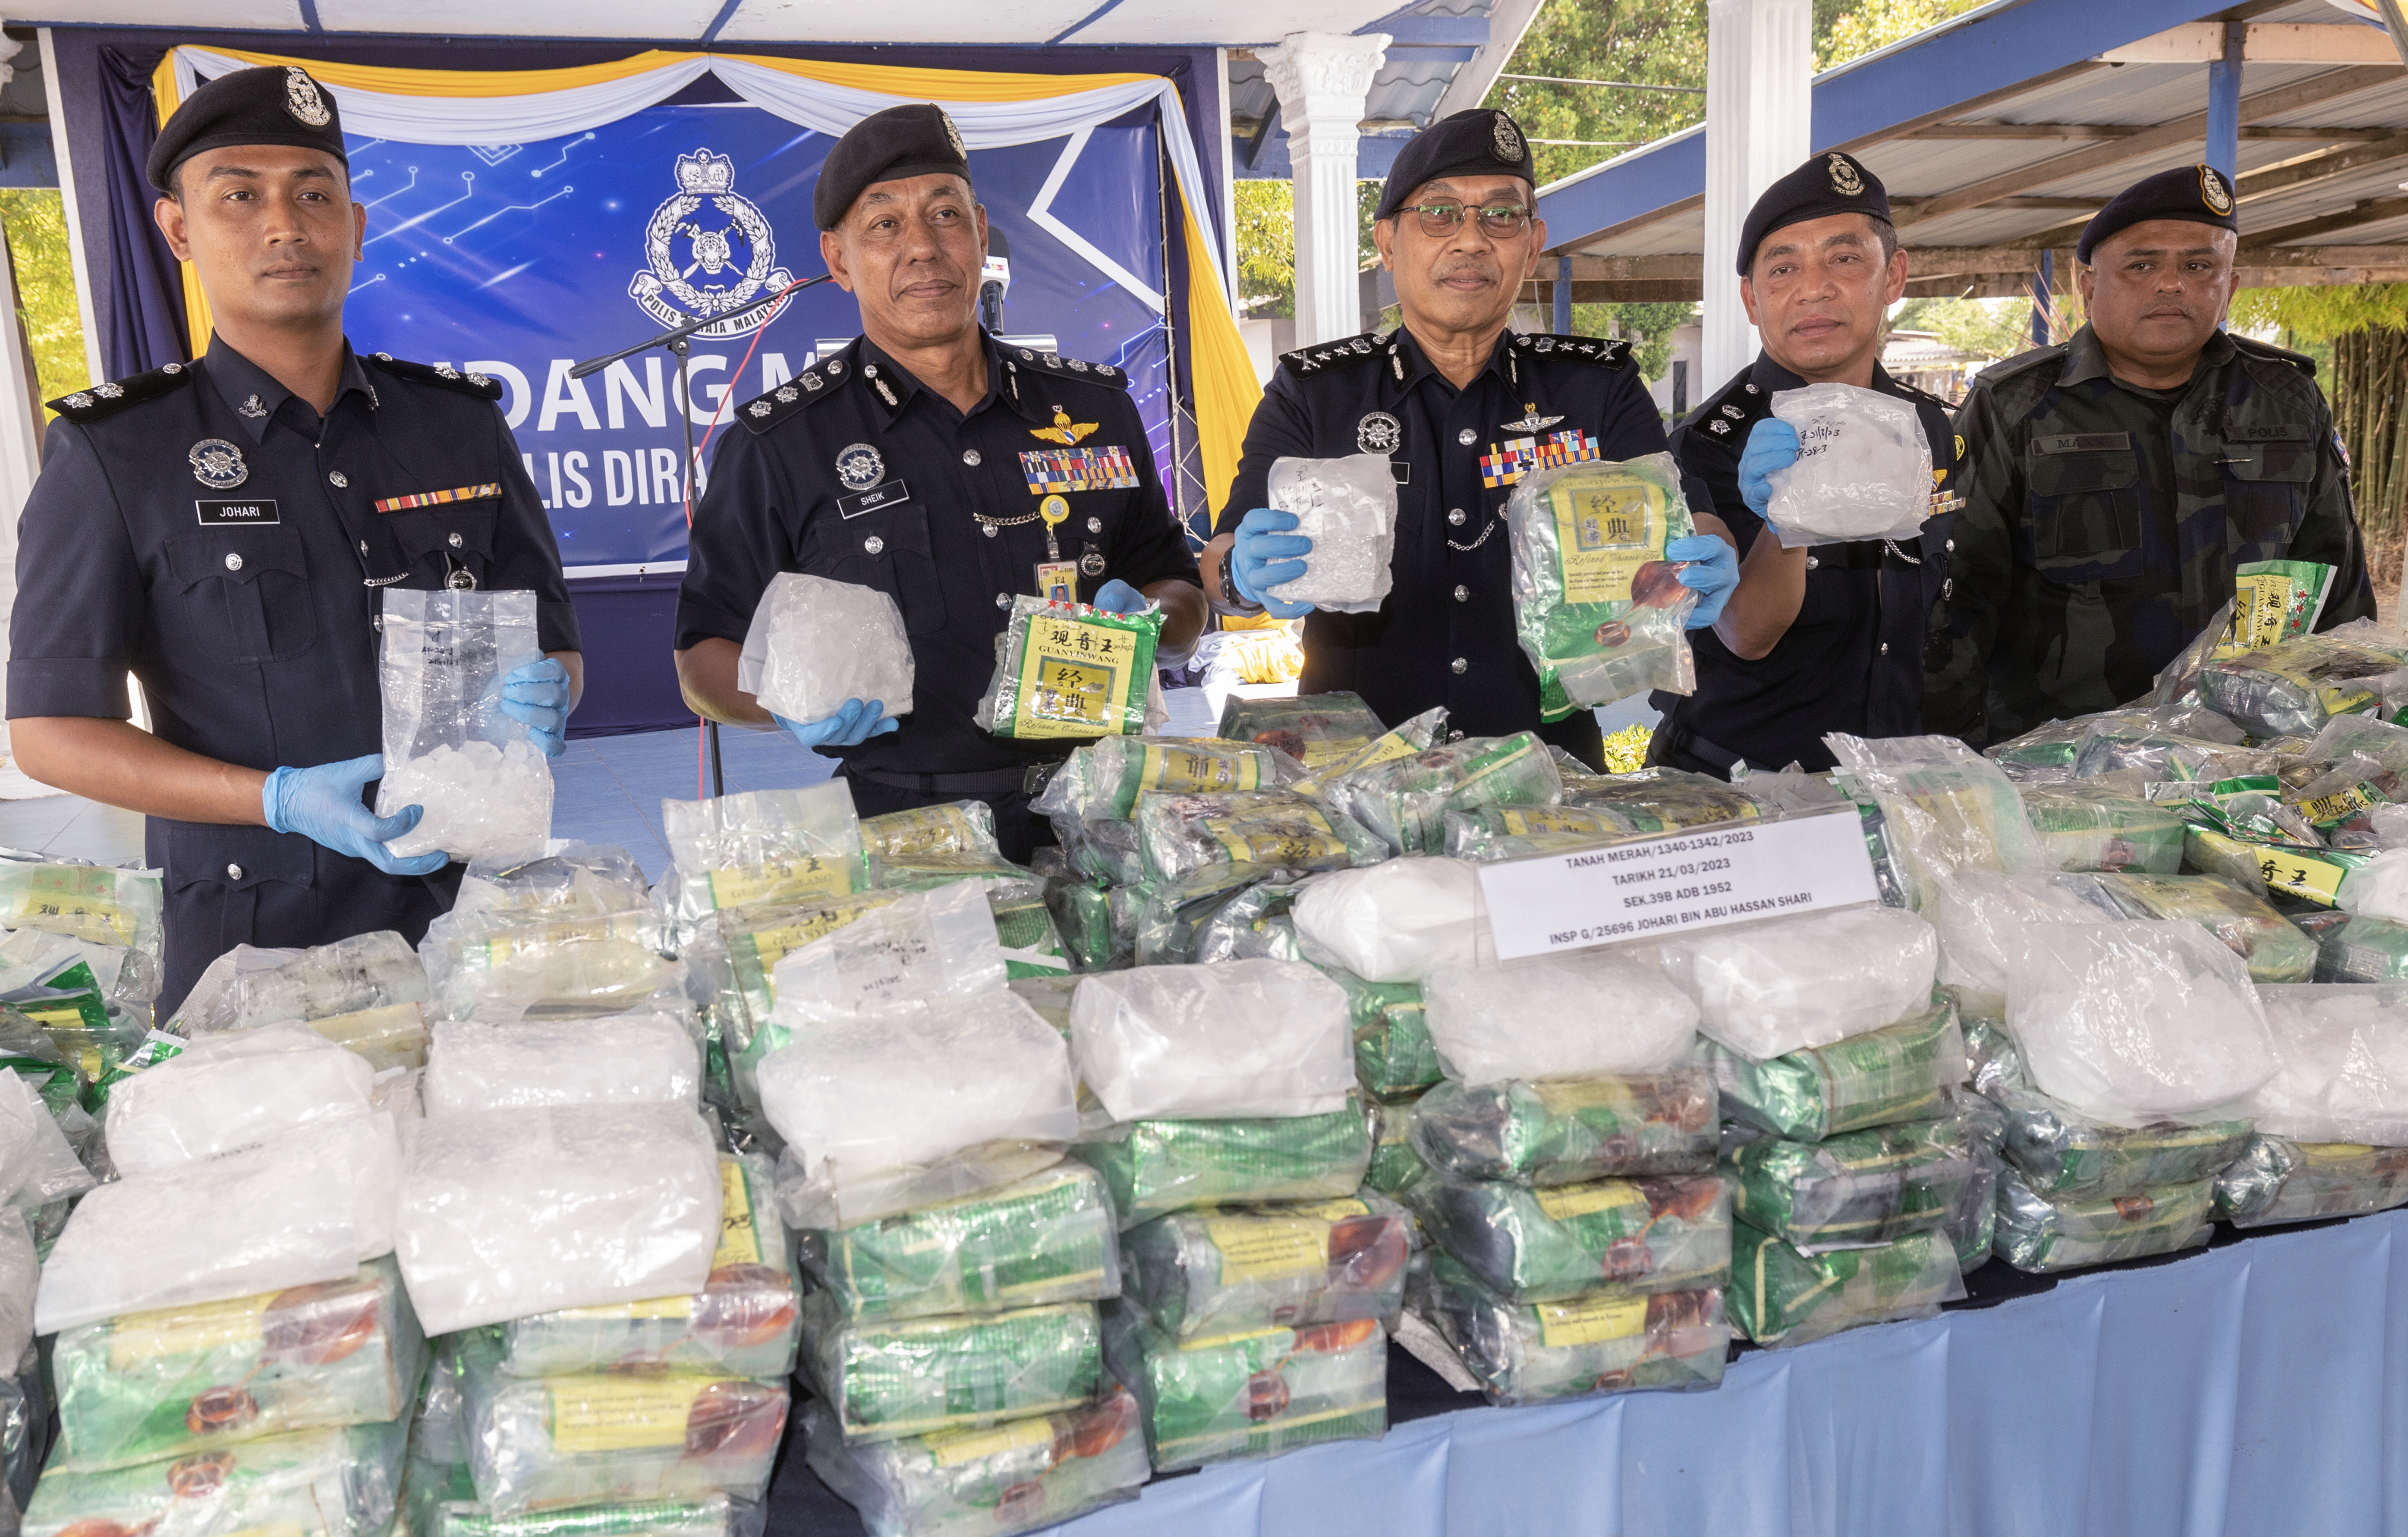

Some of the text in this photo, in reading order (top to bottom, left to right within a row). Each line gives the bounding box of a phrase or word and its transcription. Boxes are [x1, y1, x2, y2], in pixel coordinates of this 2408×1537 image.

[643, 293, 676, 323] POLIS
[695, 320, 727, 333] RAJA
[433, 355, 735, 431] DANG
[523, 446, 708, 509] LIS DIRA
[220, 506, 260, 517] JOHARI
[860, 492, 885, 506] SHEIK
[1564, 551, 1661, 567] Refined Chinese Tea
[2252, 584, 2266, 651] GUANYINWANG
[1039, 645, 1119, 664] GUANYINWANG
[1049, 630, 1113, 653] 观音王
[1017, 719, 1060, 730] Refined
[1062, 724, 1095, 734] Chinese
[1566, 831, 1753, 872] TANAH MERAH/1340-1342/2023
[1612, 858, 1730, 886] TARIKH 21/03/2023
[2260, 859, 2307, 887] 音王
[1624, 882, 1732, 908] SEK.39B ADB 1952
[1550, 892, 1812, 944] INSP G/25696 JOHARI BIN ABU HASSAN SHARI
